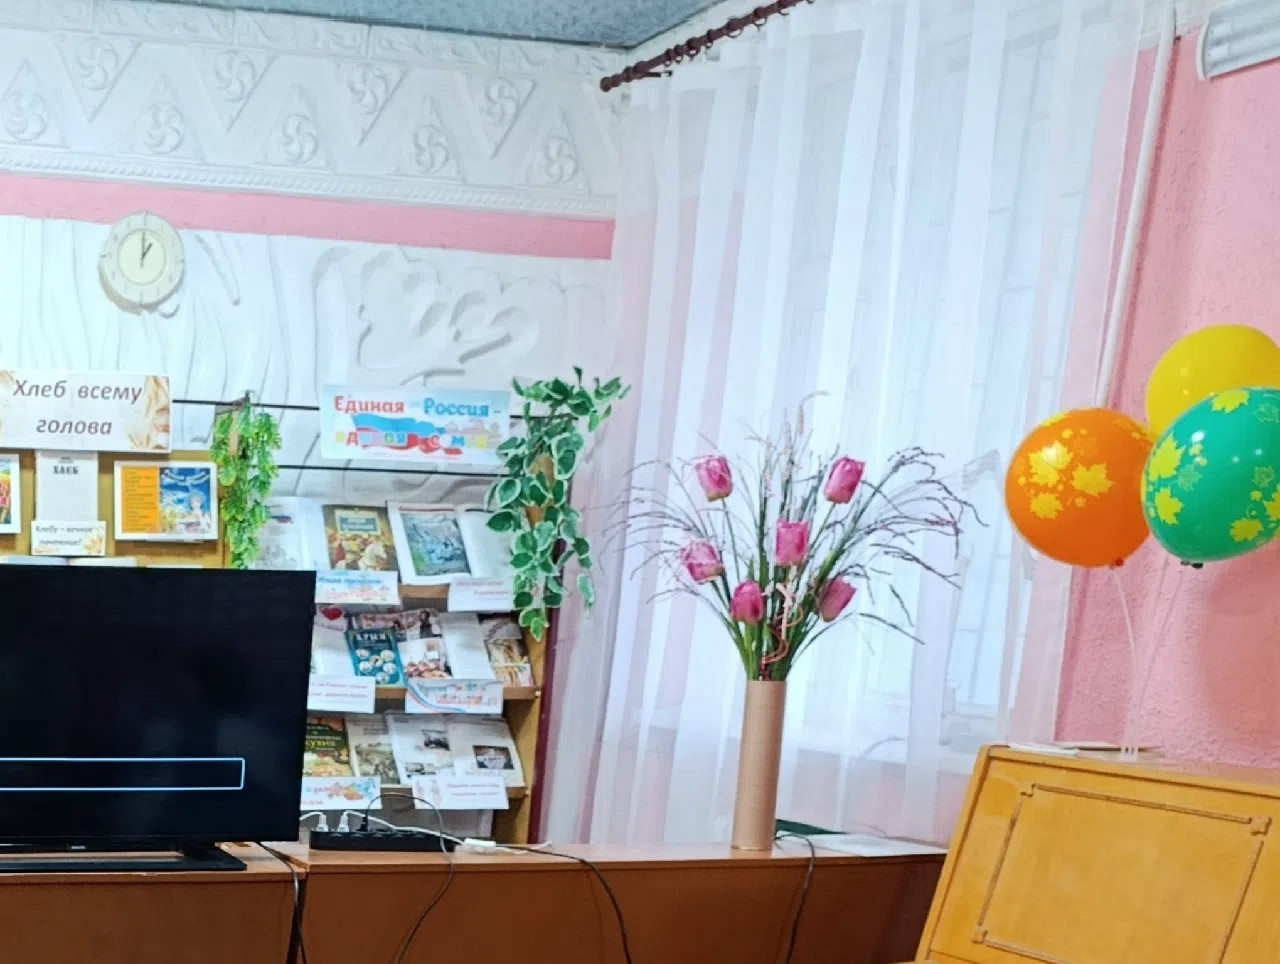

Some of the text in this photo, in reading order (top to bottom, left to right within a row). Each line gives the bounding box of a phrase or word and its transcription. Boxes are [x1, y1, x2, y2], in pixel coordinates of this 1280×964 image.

[13, 379, 142, 402] Хлеб всему
[334, 395, 405, 414] Единая
[423, 397, 489, 417] Россия
[36, 420, 112, 436] голова
